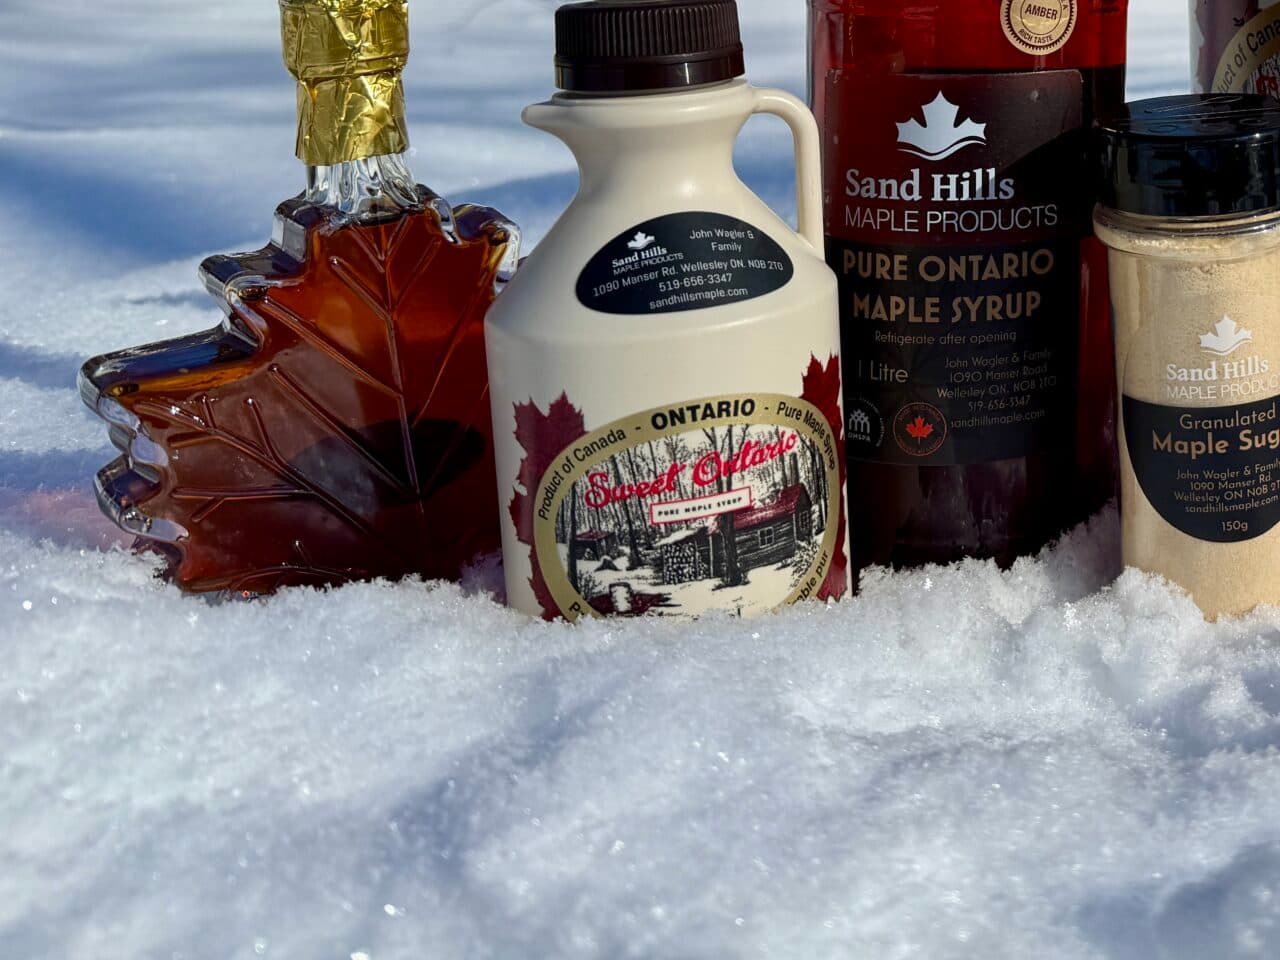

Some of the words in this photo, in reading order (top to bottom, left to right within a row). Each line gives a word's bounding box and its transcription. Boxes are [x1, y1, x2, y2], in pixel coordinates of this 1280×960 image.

[1024, 3, 1058, 20] AMBER
[1018, 28, 1032, 41] RICH
[1034, 34, 1054, 44] TASTE
[1233, 43, 1248, 68] of
[846, 167, 922, 201] Sand
[931, 167, 1015, 202] Hills
[845, 205, 919, 232] MAPLE
[926, 204, 1058, 233] PRODUCTS
[689, 228, 713, 240] John
[715, 228, 745, 241] Wagler
[612, 251, 639, 268] Sand
[641, 247, 667, 260] Hills
[711, 241, 742, 253] Family
[613, 262, 641, 276] MAPLE
[640, 252, 684, 268] PRODUCTS
[844, 248, 908, 281] PURE
[918, 248, 1054, 282] ONTARIO
[593, 279, 620, 297] 1090
[621, 270, 660, 288] Manser
[661, 265, 679, 277] Rd.
[680, 259, 729, 273] Wellesley
[658, 272, 733, 292] 519-656-3347
[649, 287, 748, 310] sandhillsmaple.com
[853, 292, 940, 323] MAPLE
[951, 291, 1041, 323] SYRUP
[874, 329, 936, 346] Refrigerate
[939, 333, 968, 345] after
[970, 330, 1017, 345] opening
[869, 359, 910, 383] Litre
[1166, 362, 1218, 382] Sand
[1223, 355, 1269, 380] Hills
[1167, 385, 1217, 400] MAPLE
[1179, 401, 1277, 430] Granulated
[1152, 429, 1229, 460] Maple
[538, 470, 565, 521] Product
[562, 455, 576, 474] of
[573, 429, 626, 462] Canada
[651, 398, 756, 431] ONTARIO
[777, 401, 803, 421] Pure
[803, 409, 826, 441] Maple
[822, 434, 837, 471] Syrup
[584, 463, 687, 509] Sweet
[692, 431, 799, 487] Ontario
[1176, 468, 1199, 481] John
[1202, 468, 1240, 481] Wagler
[1243, 466, 1251, 477] &
[1189, 481, 1215, 492] 1090
[1218, 478, 1256, 490] Manser
[1258, 471, 1273, 484] Rd.
[657, 506, 680, 518] PURE
[684, 502, 713, 515] MAPLE
[716, 496, 744, 509] SYRUP
[1173, 491, 1221, 504] Wellesley
[1224, 490, 1243, 501] ON
[1185, 494, 1279, 514] sandhillsmaple.com
[1222, 520, 1249, 532] 150g
[815, 551, 829, 578] pur
